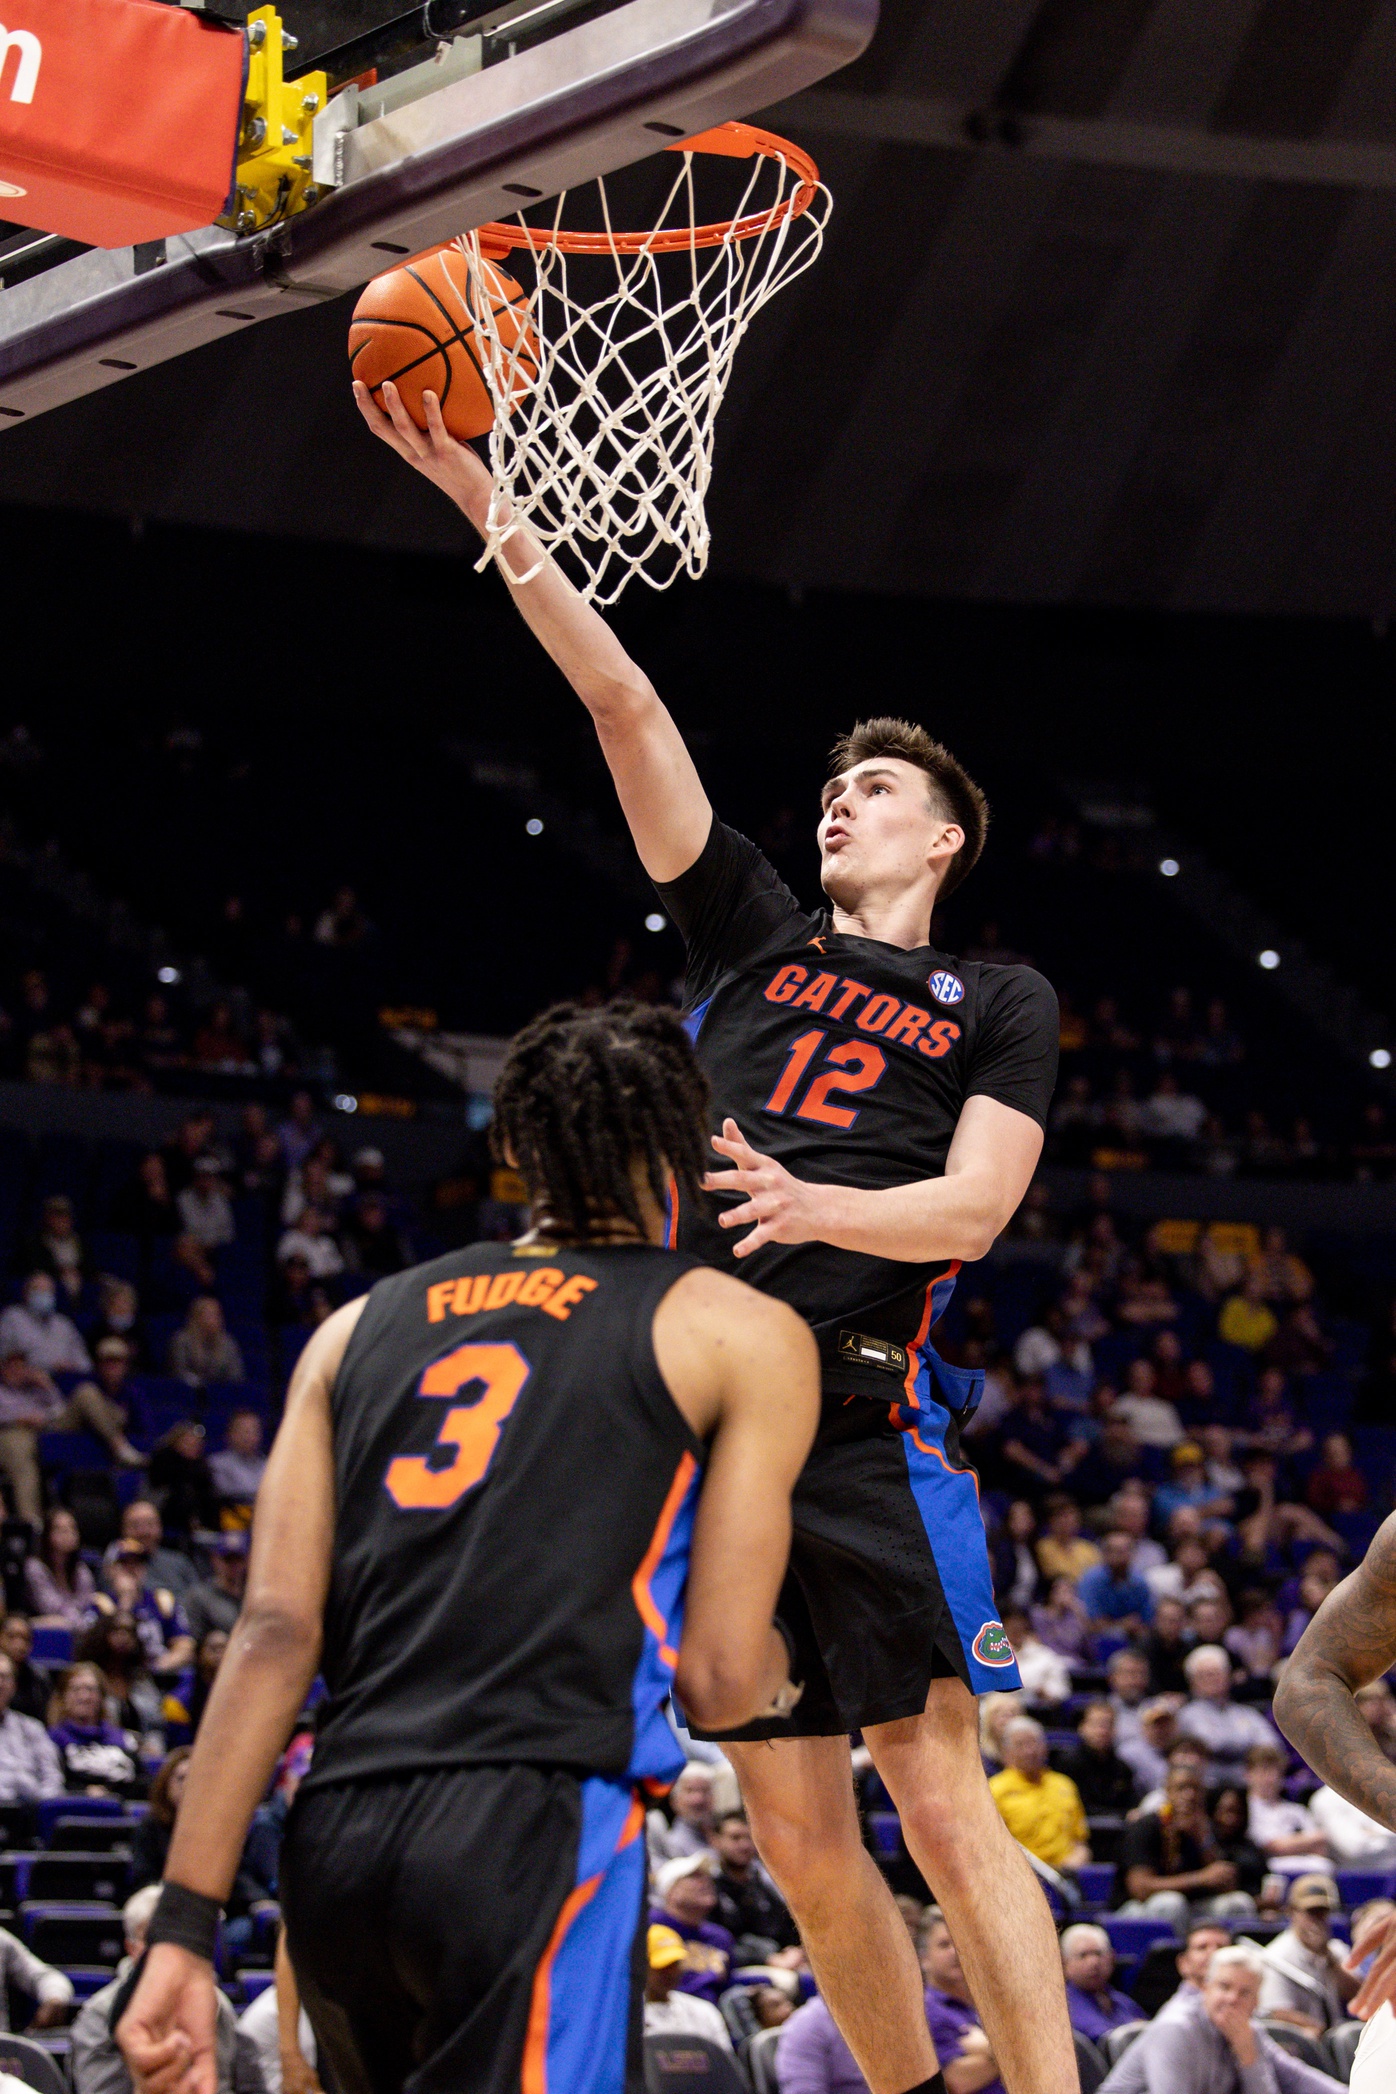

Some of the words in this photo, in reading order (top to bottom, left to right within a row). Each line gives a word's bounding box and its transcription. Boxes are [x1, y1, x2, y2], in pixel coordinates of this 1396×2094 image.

[763, 964, 962, 1059] GATORS
[930, 971, 962, 1003] SEC
[762, 1027, 889, 1130] 12
[427, 1267, 599, 1324] FUDGE
[890, 1350, 902, 1362] 50
[385, 1340, 534, 1511] 3
